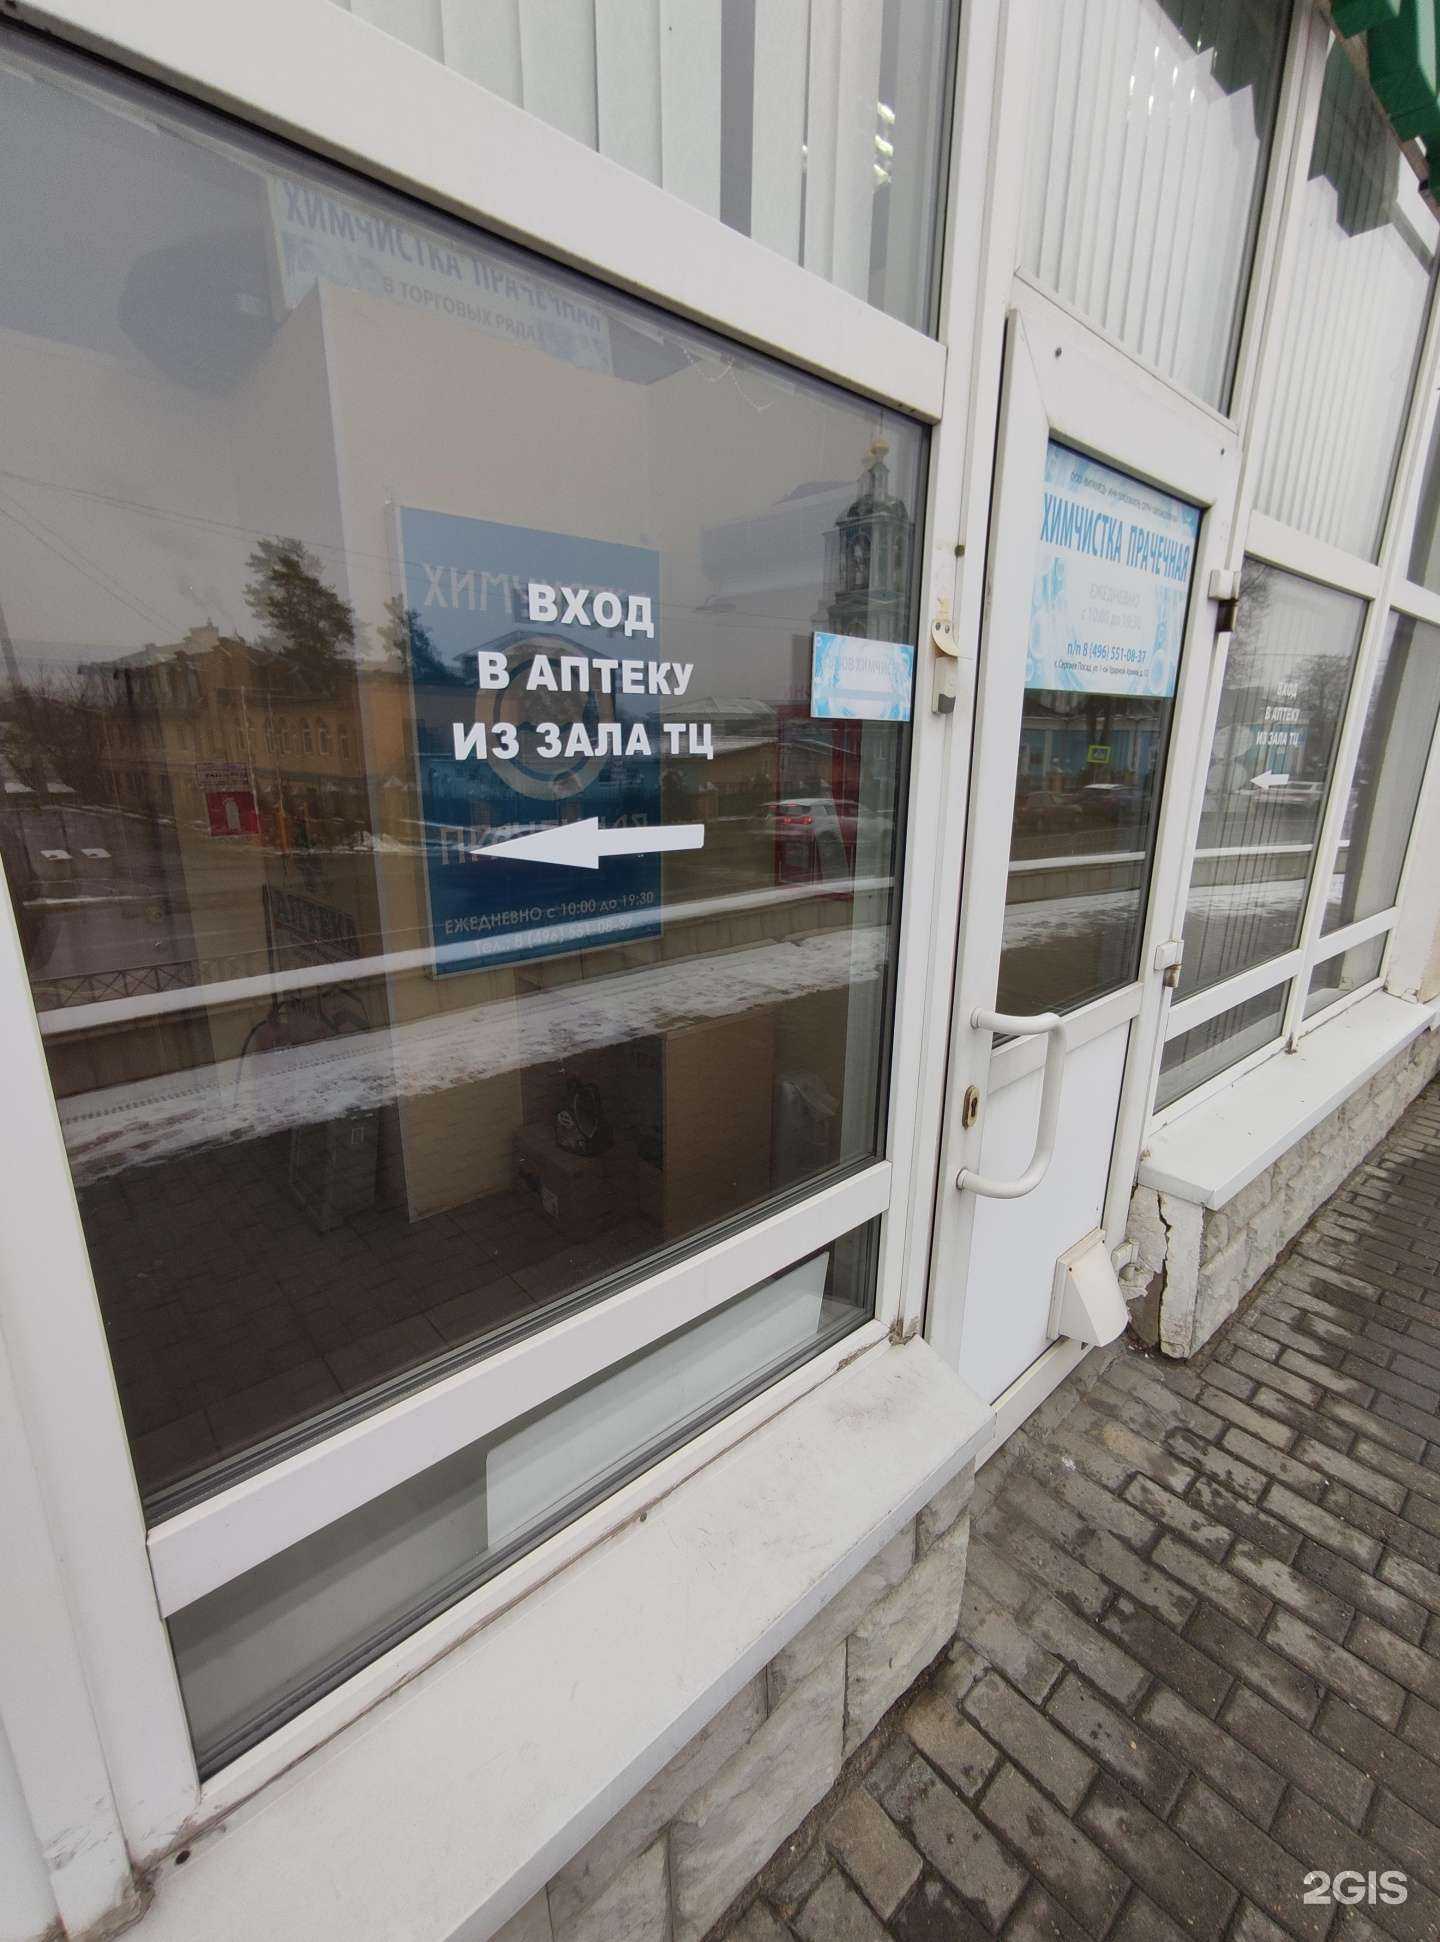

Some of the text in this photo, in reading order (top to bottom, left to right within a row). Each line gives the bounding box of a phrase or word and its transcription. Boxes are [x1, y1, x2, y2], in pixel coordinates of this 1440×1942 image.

[286, 183, 462, 281] ХИМЧИСТКА
[400, 279, 493, 327] ТОРГОВЫХ
[1040, 492, 1123, 564] ХИМЧИСТКА
[1126, 524, 1191, 583] ПРАЧЕЧНАЯ
[528, 583, 655, 639] ВХОД
[478, 650, 694, 696] В АПТЕКУ
[1088, 642, 1109, 660] (496)
[453, 722, 714, 761] ИЗ ЗАЛА ТЦ
[444, 891, 655, 935] ЕЖЕДНЕВНО с 10:00 до 19:30
